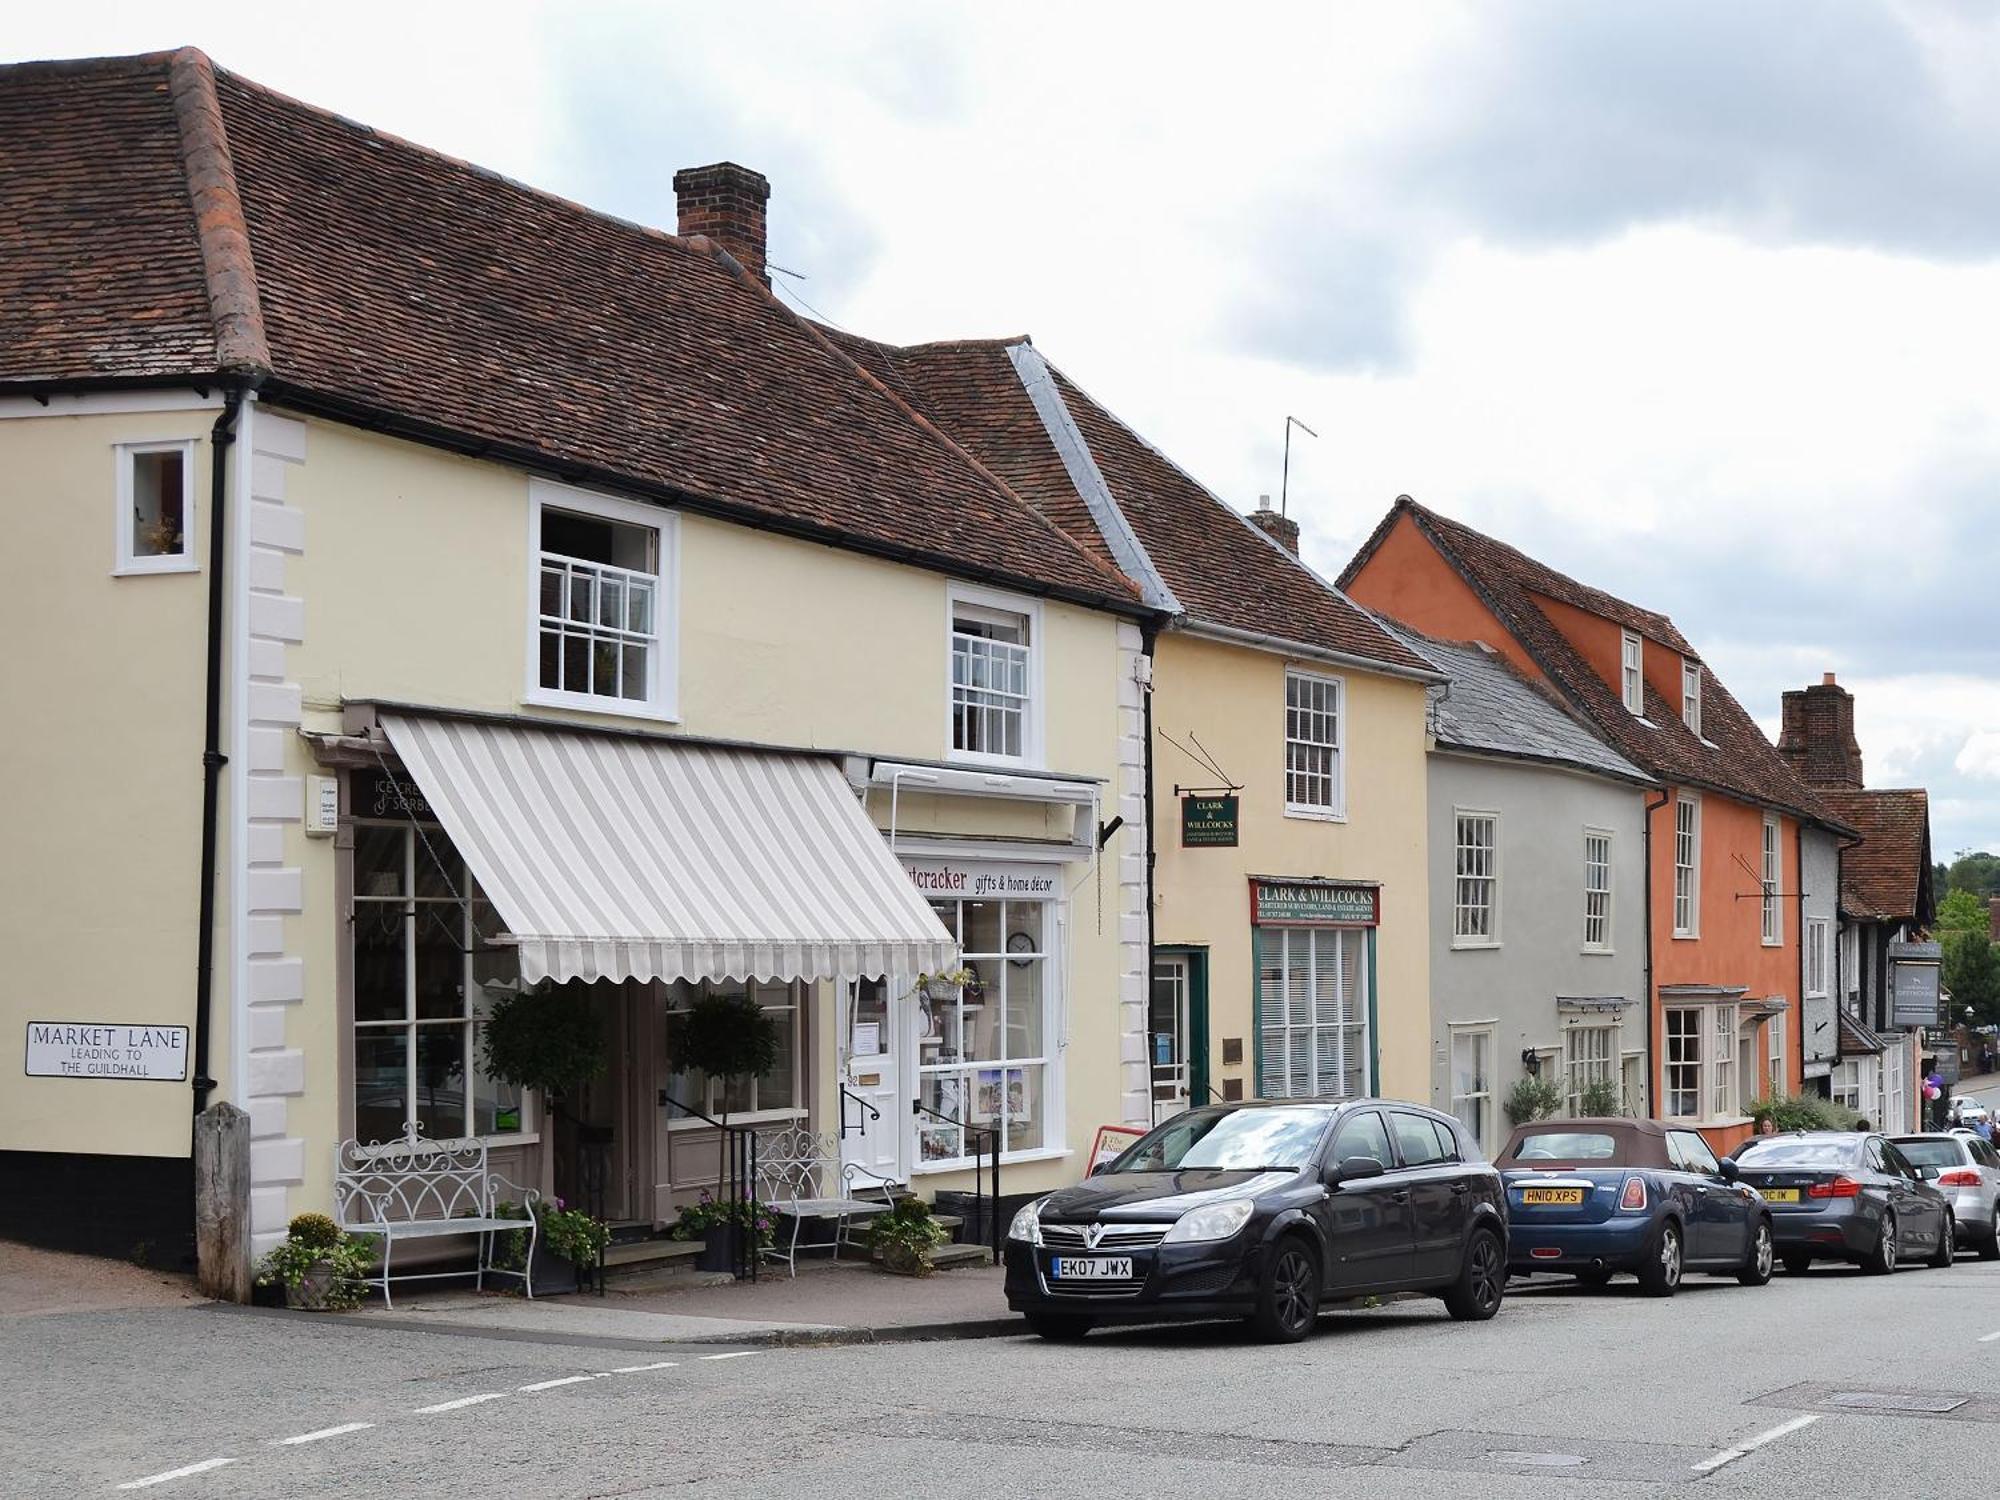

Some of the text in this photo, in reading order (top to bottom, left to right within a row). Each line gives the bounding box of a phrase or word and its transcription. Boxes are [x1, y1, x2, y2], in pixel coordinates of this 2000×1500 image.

[375, 780, 393, 793] ICE
[1207, 811, 1213, 819] &
[1187, 821, 1233, 829] WILLCOCKS
[908, 866, 1052, 895] tcracker gifts & home décor
[1257, 886, 1373, 904] CLARK & WILLCOCKS
[33, 1026, 181, 1049] MARKET LANE
[71, 1048, 142, 1060] LEADING TO
[61, 1061, 149, 1076] THE GUILDHALL
[1527, 1191, 1577, 1202] HN10 XPS
[1060, 1260, 1129, 1276] EK07 JWX
